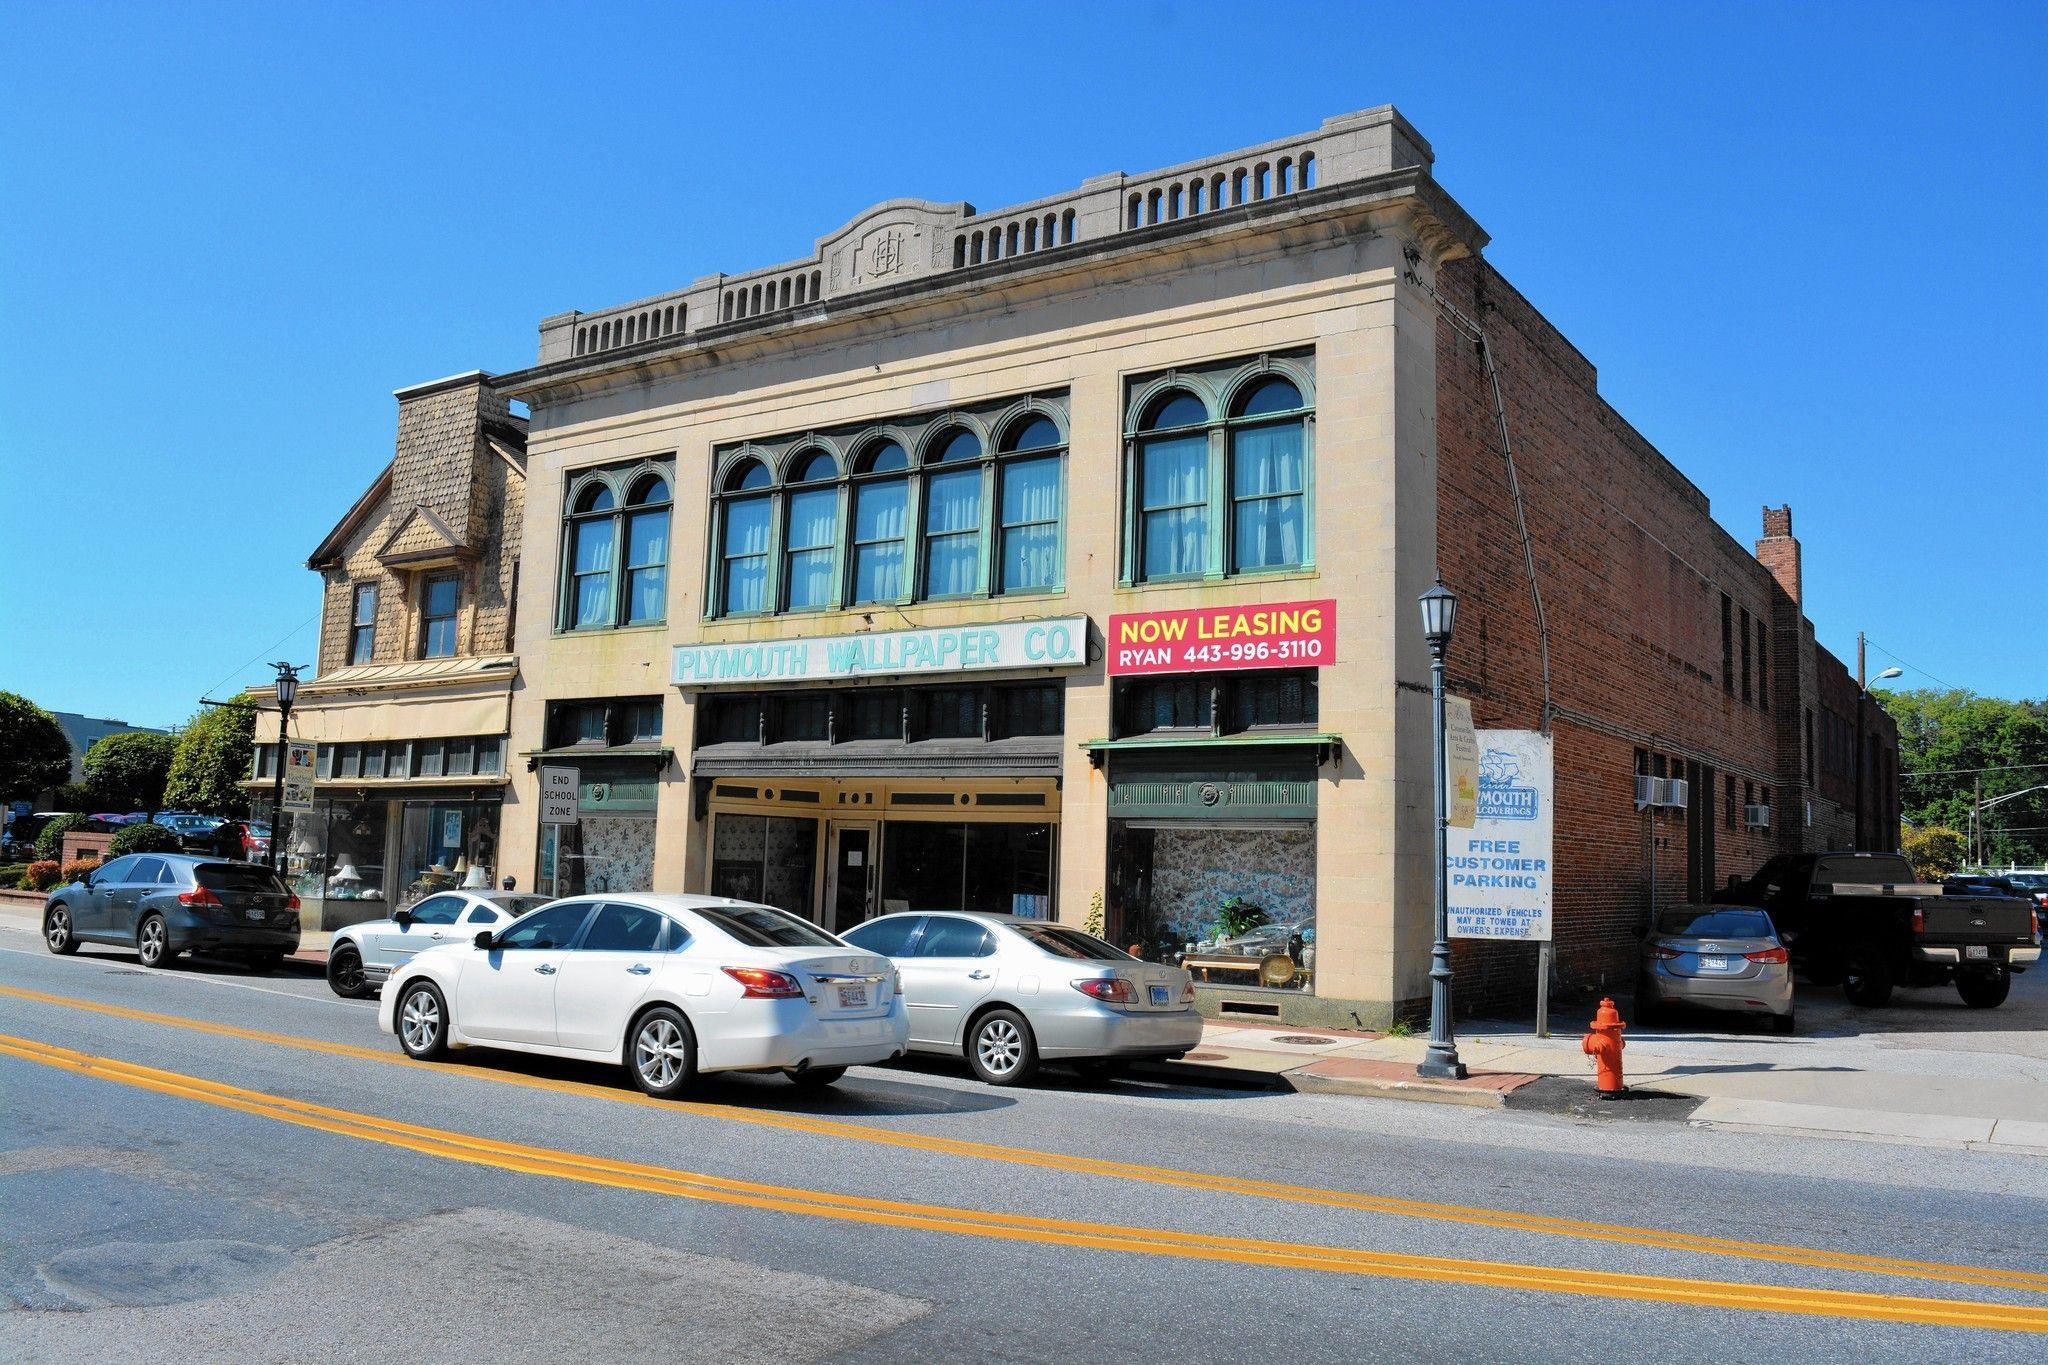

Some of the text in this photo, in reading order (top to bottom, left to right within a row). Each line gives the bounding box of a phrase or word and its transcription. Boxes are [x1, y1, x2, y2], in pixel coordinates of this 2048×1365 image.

[1120, 609, 1322, 644] NOW LEASING
[678, 625, 1076, 680] PLYMOUTH WALLPAPER CO.
[1119, 639, 1322, 667] RYAN 443-996-3110
[552, 775, 570, 785] END
[544, 790, 577, 801] SCHOOL
[549, 806, 571, 816] ZONE
[1468, 839, 1521, 854] FREE
[1446, 856, 1547, 872] CUSTOMER
[1453, 873, 1537, 889] PARKING
[1506, 908, 1542, 918] VEHICLES
[1456, 916, 1531, 927] MAY BE TOWED AT
[1457, 925, 1532, 937] OWNER'S EXPENSE.
